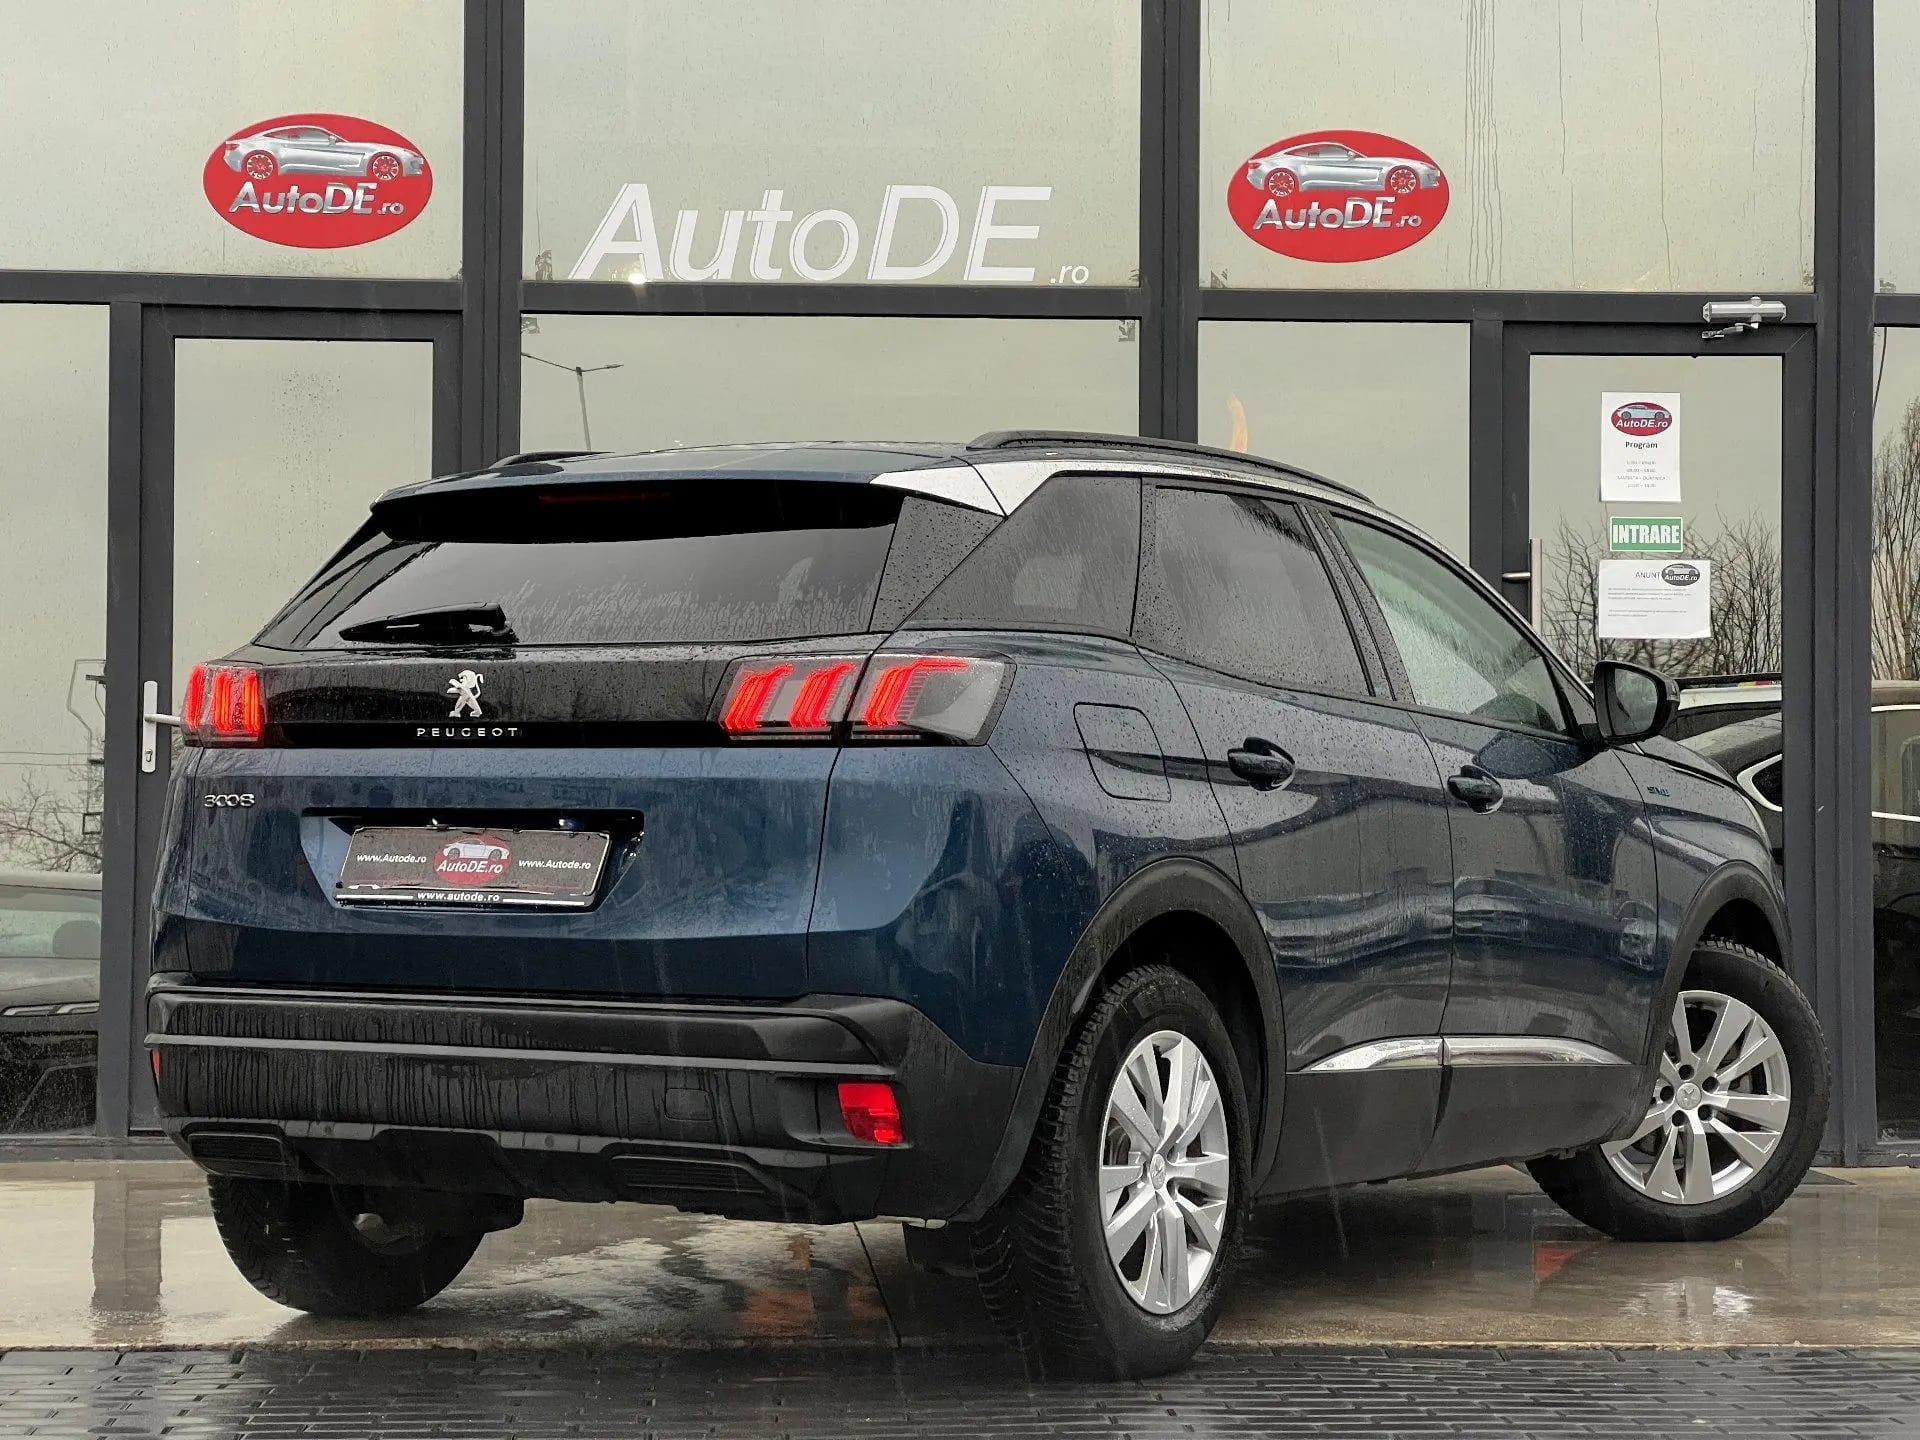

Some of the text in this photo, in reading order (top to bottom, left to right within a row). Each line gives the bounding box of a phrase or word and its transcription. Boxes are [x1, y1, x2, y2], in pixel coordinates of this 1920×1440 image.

[1616, 419, 1668, 428] AutoDE.ro
[1625, 441, 1658, 449] Program
[1613, 525, 1679, 543] INTRARE
[416, 727, 519, 738] PEUGEOT
[204, 793, 255, 807] 3008
[356, 852, 427, 864] www.Autode.ro
[436, 859, 504, 874] AutoDE.ro
[518, 858, 592, 871] www.Autode.ro
[417, 891, 500, 902] www.autode.ro
